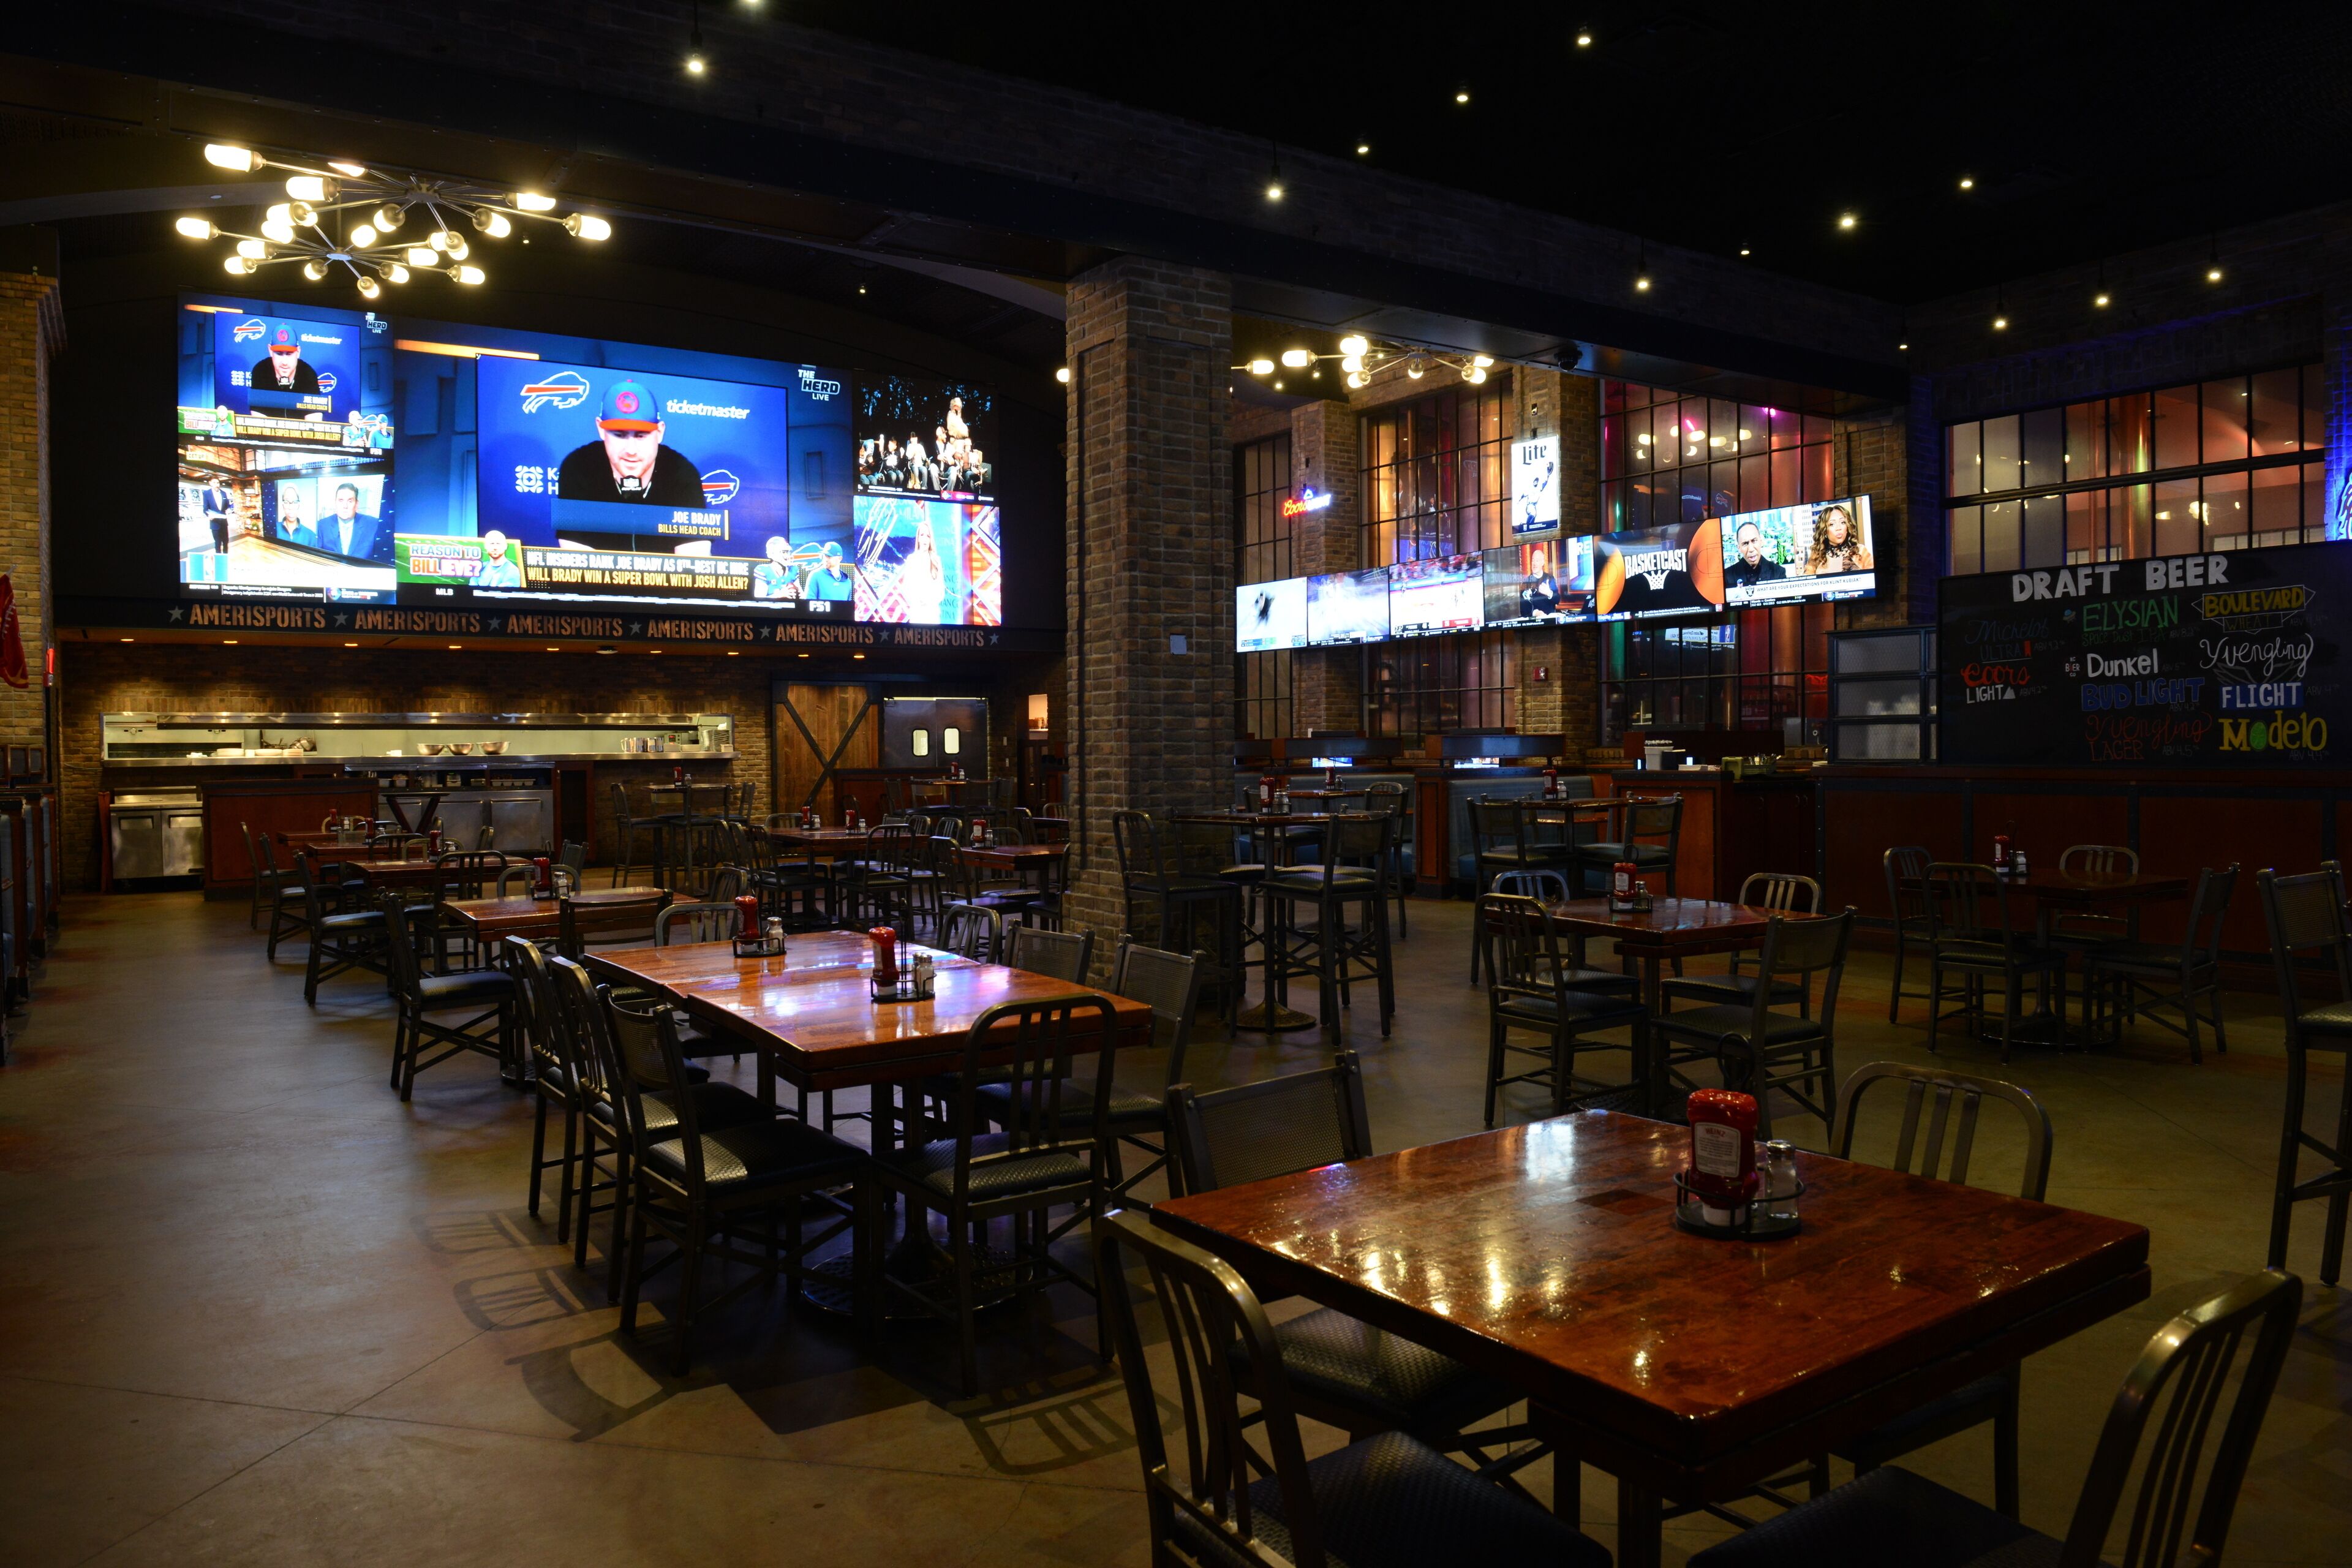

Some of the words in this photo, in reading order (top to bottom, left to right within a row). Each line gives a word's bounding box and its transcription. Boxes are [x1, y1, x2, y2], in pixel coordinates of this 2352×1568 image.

[368, 321, 387, 330] HERD
[798, 369, 815, 379] THE
[802, 379, 840, 394] HERD
[812, 393, 829, 401] LIVE
[666, 399, 750, 420] ticketmaster
[1523, 444, 1547, 466] Lite
[672, 511, 688, 524] JOE
[691, 513, 722, 526] BRADY
[658, 524, 677, 534] BILLS
[679, 525, 698, 535] HEAD
[699, 526, 722, 537] COACH
[412, 545, 461, 557] REASON
[466, 547, 480, 557] TO
[616, 556, 632, 570] JOE
[634, 557, 662, 572] BRADY
[663, 559, 675, 572] AS
[1624, 548, 1687, 579] BASKETCAST
[527, 567, 550, 582] WILL
[551, 568, 583, 583] BRADY
[584, 570, 603, 584] WIN
[604, 571, 611, 584] A
[612, 571, 642, 586] SUPER
[643, 573, 668, 587] BOWL
[670, 574, 692, 587] WITH
[693, 575, 716, 589] JOSH
[717, 576, 748, 590] ALLEN?
[2011, 564, 2119, 602] DRAFT
[2145, 555, 2230, 591] BEER
[809, 601, 831, 612] FS1
[2082, 595, 2179, 632] ELYSIAN
[2204, 587, 2304, 618] BOULEVARD
[190, 603, 325, 628] AMERISPORTS
[355, 611, 480, 633] AMERISPORTS
[507, 614, 623, 638] AMERISPORTS
[2225, 614, 2273, 631] WHEAT
[647, 619, 754, 641] AMERISPORTS
[776, 622, 873, 644] AMERISPORTS
[894, 627, 984, 647] AMERISPORTS
[1964, 617, 2049, 644] Michelob
[1980, 643, 2022, 662] ULTRA
[2087, 647, 2159, 678] Dunkel
[2199, 633, 2314, 677] Yuengling
[1961, 662, 2032, 687] Coors
[1966, 684, 2005, 704] LIGHT
[2081, 683, 2132, 712] BUD
[2135, 676, 2206, 706] LIGHT
[2222, 682, 2302, 708] FLIGHT
[2084, 710, 2213, 751] Yuengling
[2217, 709, 2328, 752] Modelo
[2089, 739, 2146, 762] LAGER
